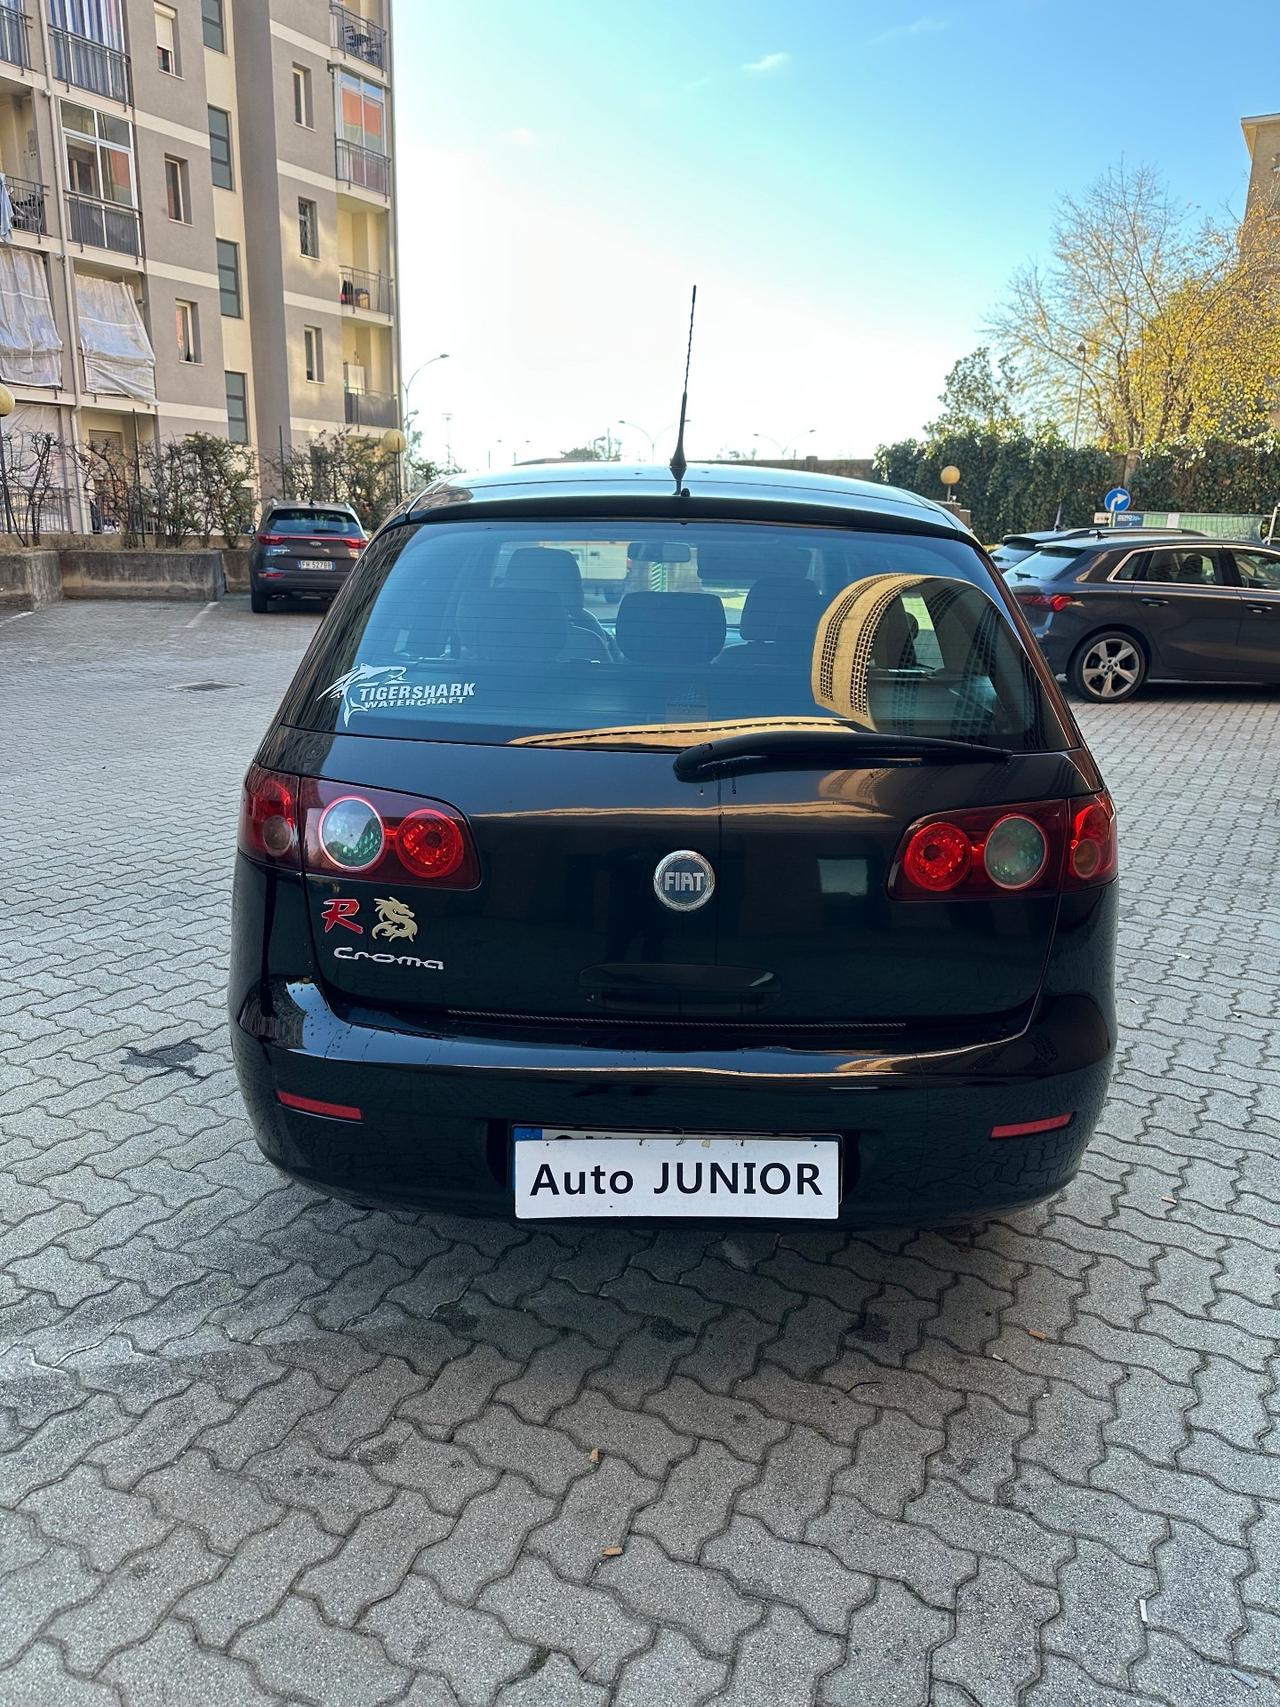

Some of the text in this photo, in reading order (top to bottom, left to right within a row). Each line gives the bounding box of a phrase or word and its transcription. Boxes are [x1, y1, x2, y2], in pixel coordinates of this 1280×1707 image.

[360, 682, 476, 702] TIGERSHARK
[364, 696, 467, 709] WATERCRAFT
[664, 871, 705, 892] FIAT
[321, 899, 364, 935] R
[333, 946, 445, 971] Croma
[529, 1161, 823, 1197] Auto JUNIOR
